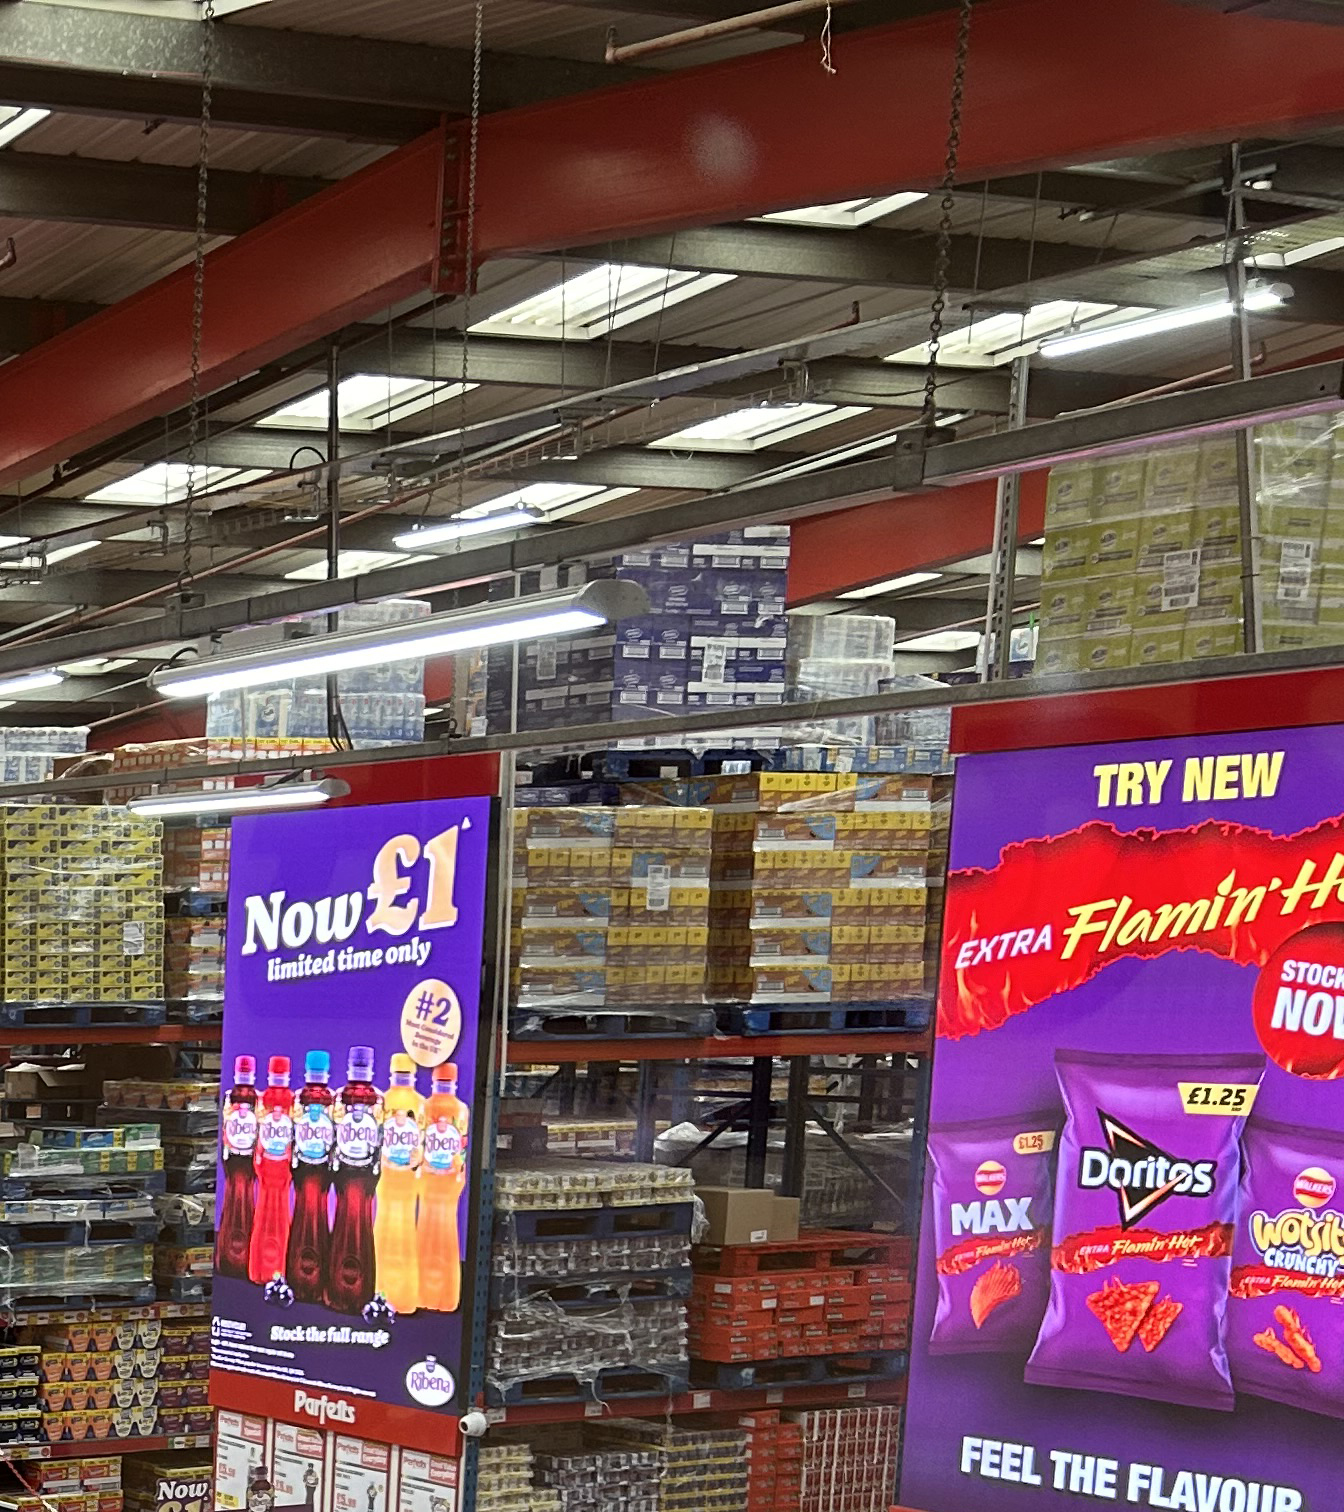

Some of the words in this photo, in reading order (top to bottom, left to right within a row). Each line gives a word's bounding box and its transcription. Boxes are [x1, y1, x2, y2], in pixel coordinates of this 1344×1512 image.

[1092, 761, 1175, 808] TRY
[1181, 750, 1285, 805] NEW
[241, 890, 363, 956] Now
[365, 825, 459, 936] £1
[954, 924, 1054, 970] EXTRA
[1061, 868, 1283, 960] Flamin'
[267, 949, 335, 982] limited
[337, 946, 383, 971] time
[385, 936, 432, 967] only
[415, 991, 451, 1027] #2
[1187, 1087, 1246, 1107] £1.25
[1081, 1150, 1214, 1194] Doritos
[951, 1197, 1033, 1235] MAX
[1264, 1248, 1339, 1277] CRUNCHY
[270, 1325, 304, 1343] Stock
[306, 1326, 326, 1343] the
[327, 1326, 350, 1344] full
[351, 1329, 390, 1348] range
[411, 1371, 451, 1393] Ribena
[960, 1436, 1042, 1486] FEEL
[1050, 1450, 1119, 1499] THE
[158, 1481, 208, 1500] Now
